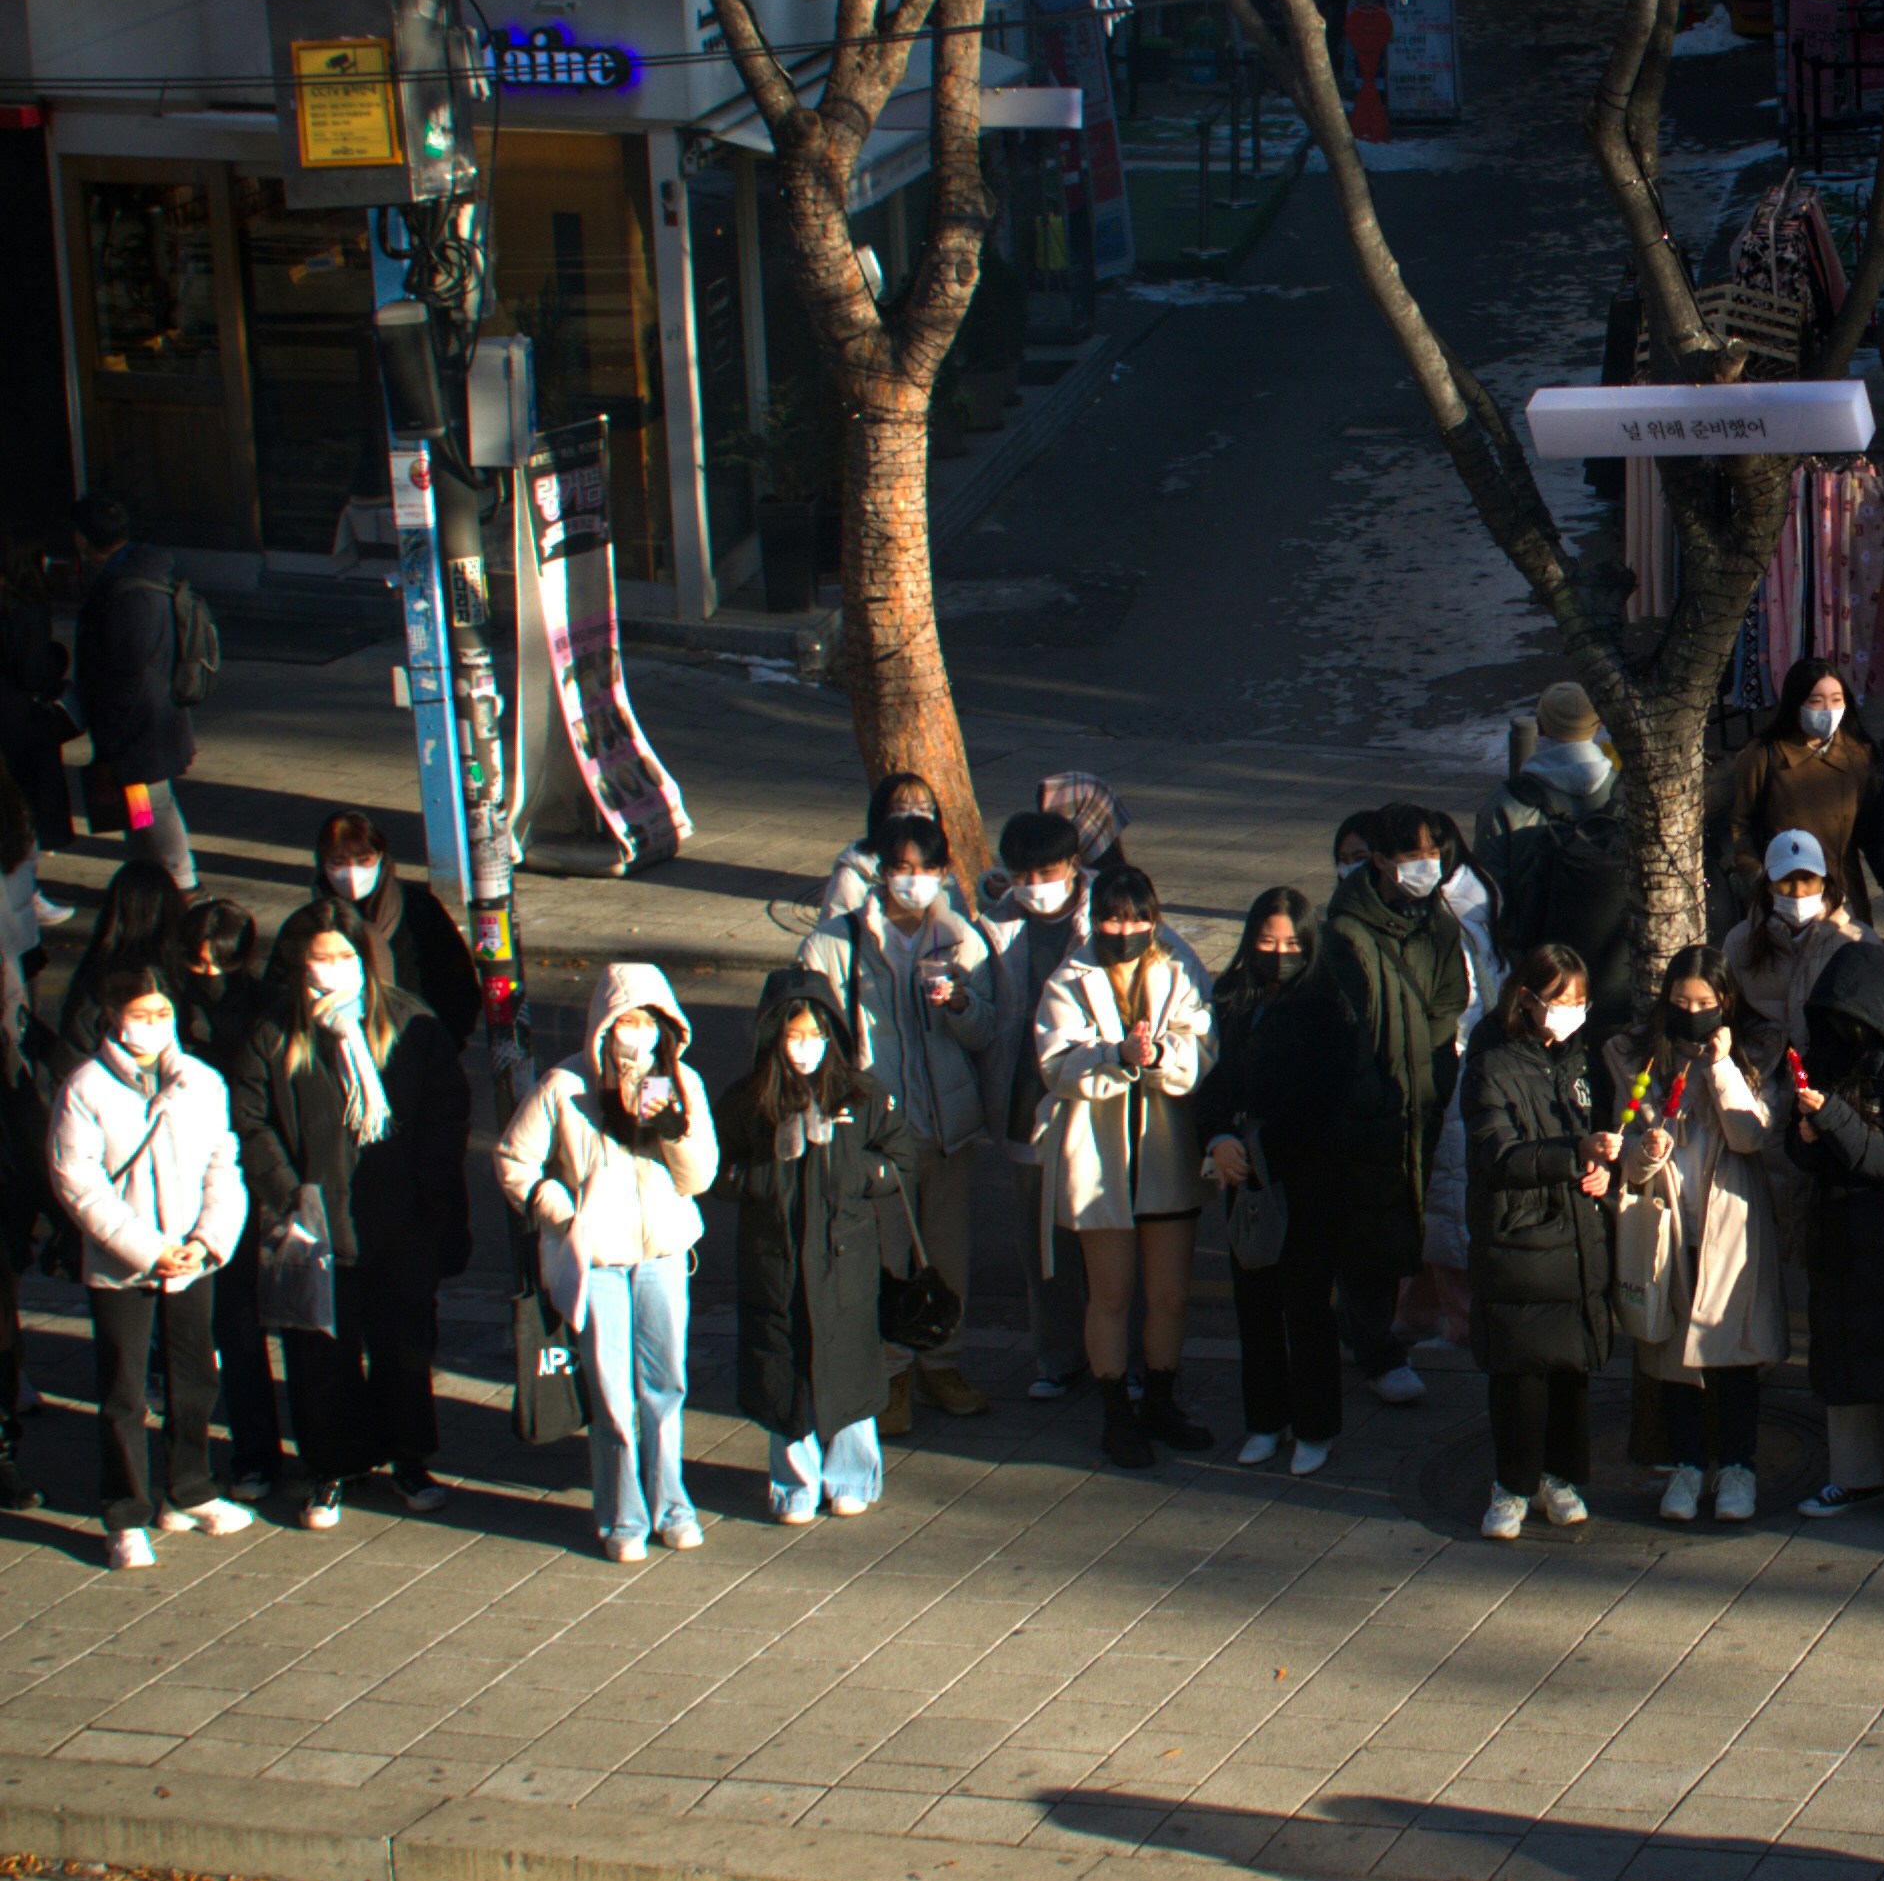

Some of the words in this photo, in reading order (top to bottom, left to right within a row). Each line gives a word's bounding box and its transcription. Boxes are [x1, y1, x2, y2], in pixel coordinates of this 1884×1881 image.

[1623, 422, 1642, 441] 널
[1648, 420, 1685, 440] 위해
[1690, 418, 1766, 440] 준비했어
